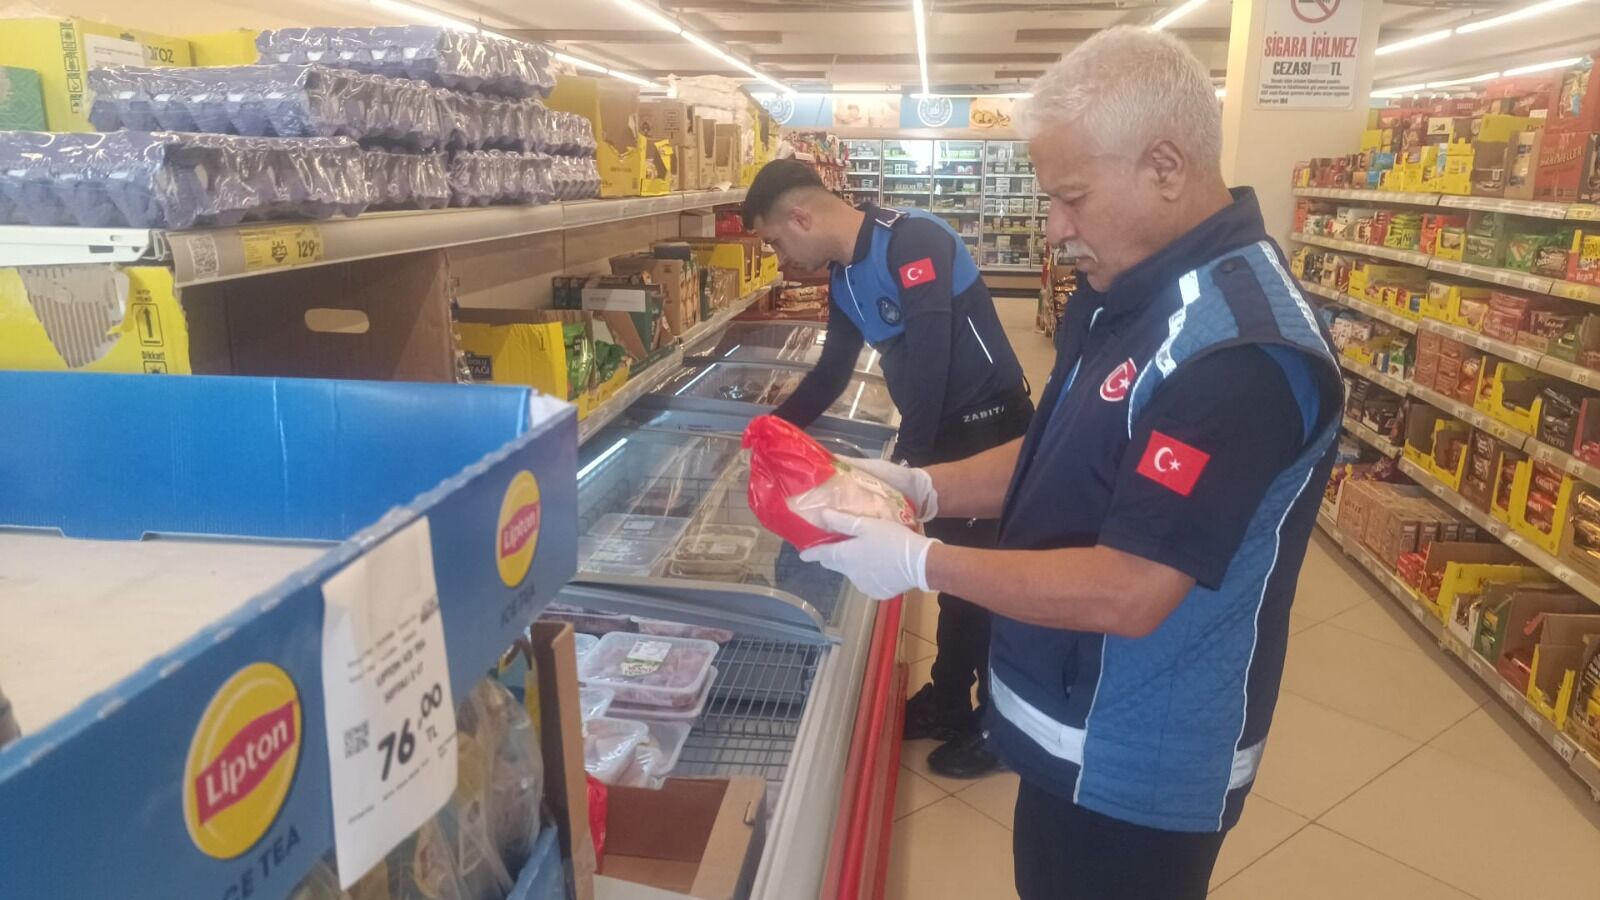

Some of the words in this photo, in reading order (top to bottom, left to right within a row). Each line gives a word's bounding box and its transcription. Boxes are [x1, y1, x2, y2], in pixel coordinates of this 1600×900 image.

[1264, 31, 1307, 57] SİGARA
[1310, 31, 1358, 61] İÇİLMEZ
[1272, 61, 1312, 75] CEZASI
[1330, 62, 1342, 76] TL
[296, 240, 316, 258] 129
[504, 511, 537, 551] Lipton
[205, 719, 288, 806] Lipton
[222, 867, 255, 900] CE
[258, 825, 301, 878] TEA
